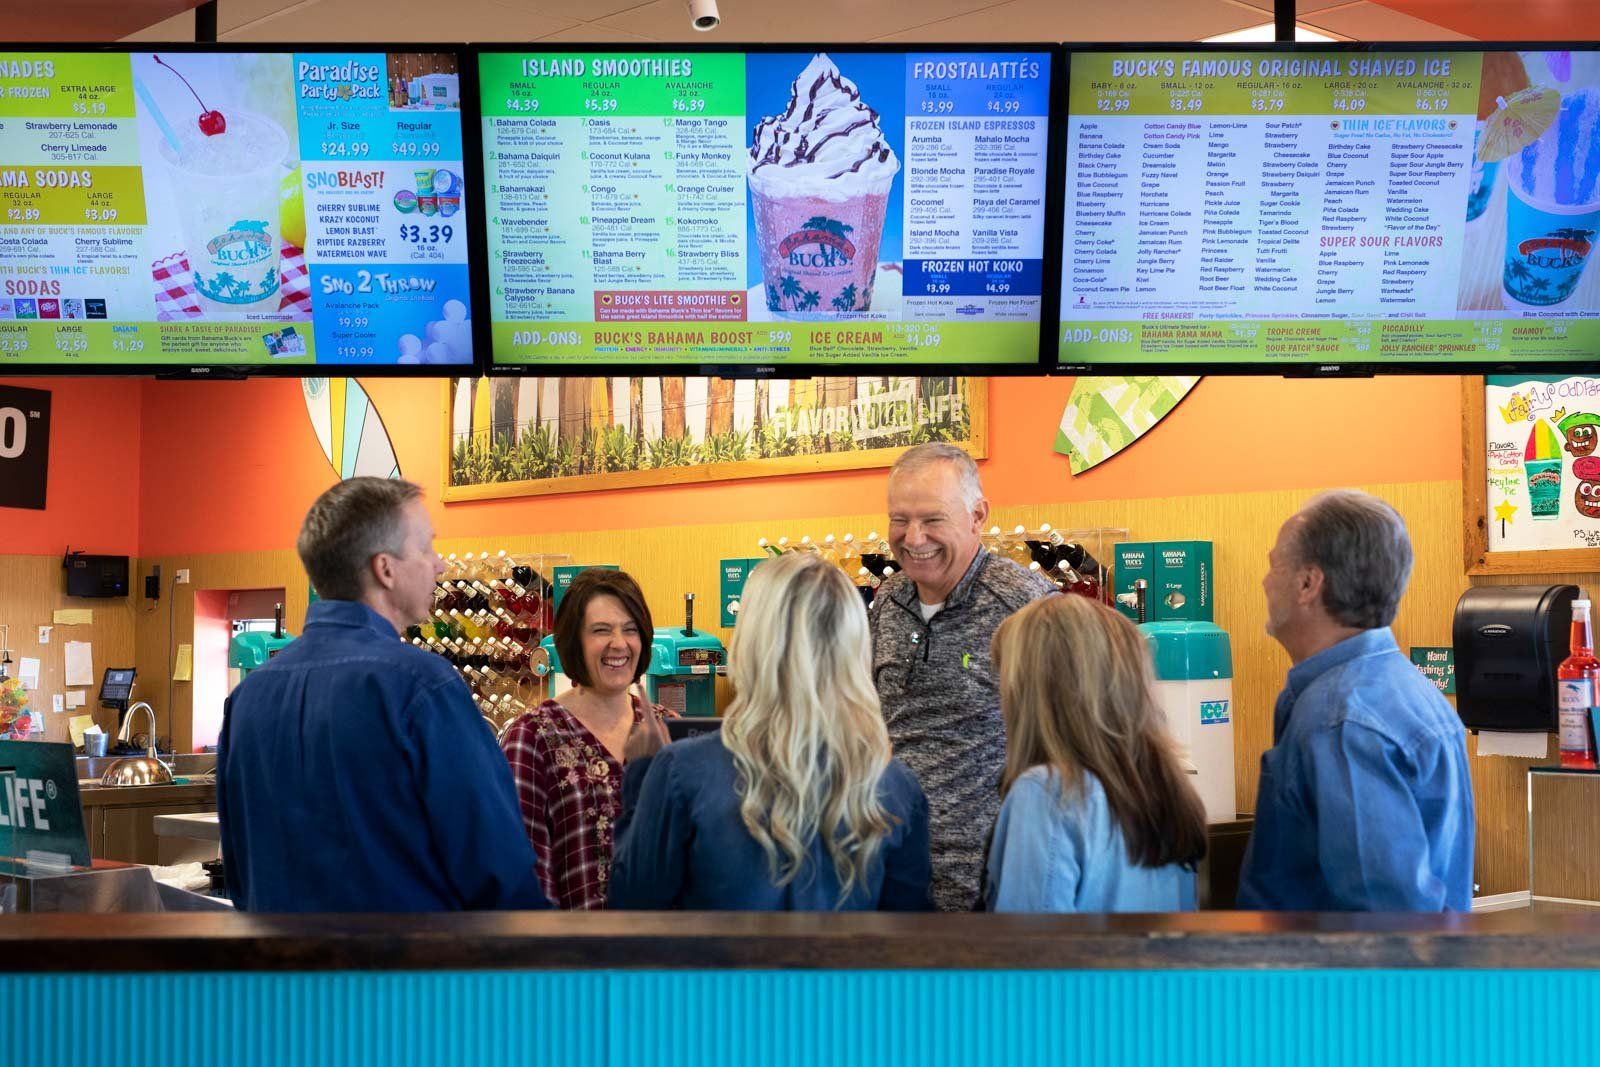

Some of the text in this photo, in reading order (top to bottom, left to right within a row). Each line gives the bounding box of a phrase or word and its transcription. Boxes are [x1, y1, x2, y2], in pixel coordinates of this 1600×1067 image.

[299, 60, 379, 82] Paradise
[522, 59, 692, 77] ISLAND SMOOTHIES
[914, 58, 1040, 79] FROSTALATTÉS
[1112, 59, 1451, 77] BUCK'S FAMOUS ORIGINAL SHAVED ICE
[9, 87, 50, 98] FROZEN
[301, 84, 380, 100] Party Pack
[72, 103, 106, 114] $5.19
[506, 99, 705, 111] $4.39 $5.39 $6.39
[922, 101, 1020, 113] $3.99 $4.99
[1097, 99, 1448, 111] $2.99 $3.49 $3.79 $4.09 $6.19
[25, 122, 70, 131] Strawberry
[397, 122, 432, 131] Regular
[676, 119, 727, 128] Mango Tango
[910, 121, 1035, 130] FROZEN ISLAND ESPRESSOS
[1343, 120, 1446, 130] THIN FLAVORS
[41, 144, 69, 153] Cherry
[322, 142, 440, 156] $24.99 $49.99
[676, 153, 731, 161] Funky Monkey
[35, 170, 92, 188] SODAS
[307, 170, 384, 189] SNOBLAST!
[591, 186, 616, 194] Congo
[677, 185, 704, 193] Orange
[8, 209, 117, 220] $2.89 $3.09
[592, 217, 629, 225] Pineapple
[400, 224, 453, 243] $3.39
[75, 238, 100, 247] Cherry
[1320, 236, 1443, 247] SUPER SOUR FLAVORS
[922, 261, 1023, 272] FROZEN HOT KOKO
[6, 280, 60, 295] SODAS
[357, 270, 372, 294] 2
[927, 284, 1010, 293] $3.99 $4.99
[615, 295, 727, 305] BUCK'S LITE SMOOTHIE
[338, 317, 368, 327] $9.99
[513, 331, 582, 346] ADD-ONS:
[594, 331, 753, 344] BUCK'S BAHAMA BOOST
[810, 331, 883, 344] ICE CREAM
[906, 335, 940, 346] $1.09
[1064, 328, 1133, 343] ADD-ONS:
[338, 347, 374, 357] $19.99
[774, 406, 850, 440] FLAVOR
[917, 394, 963, 425] LIFE
[1427, 651, 1448, 661] Hand
[1415, 664, 1444, 676] ashing
